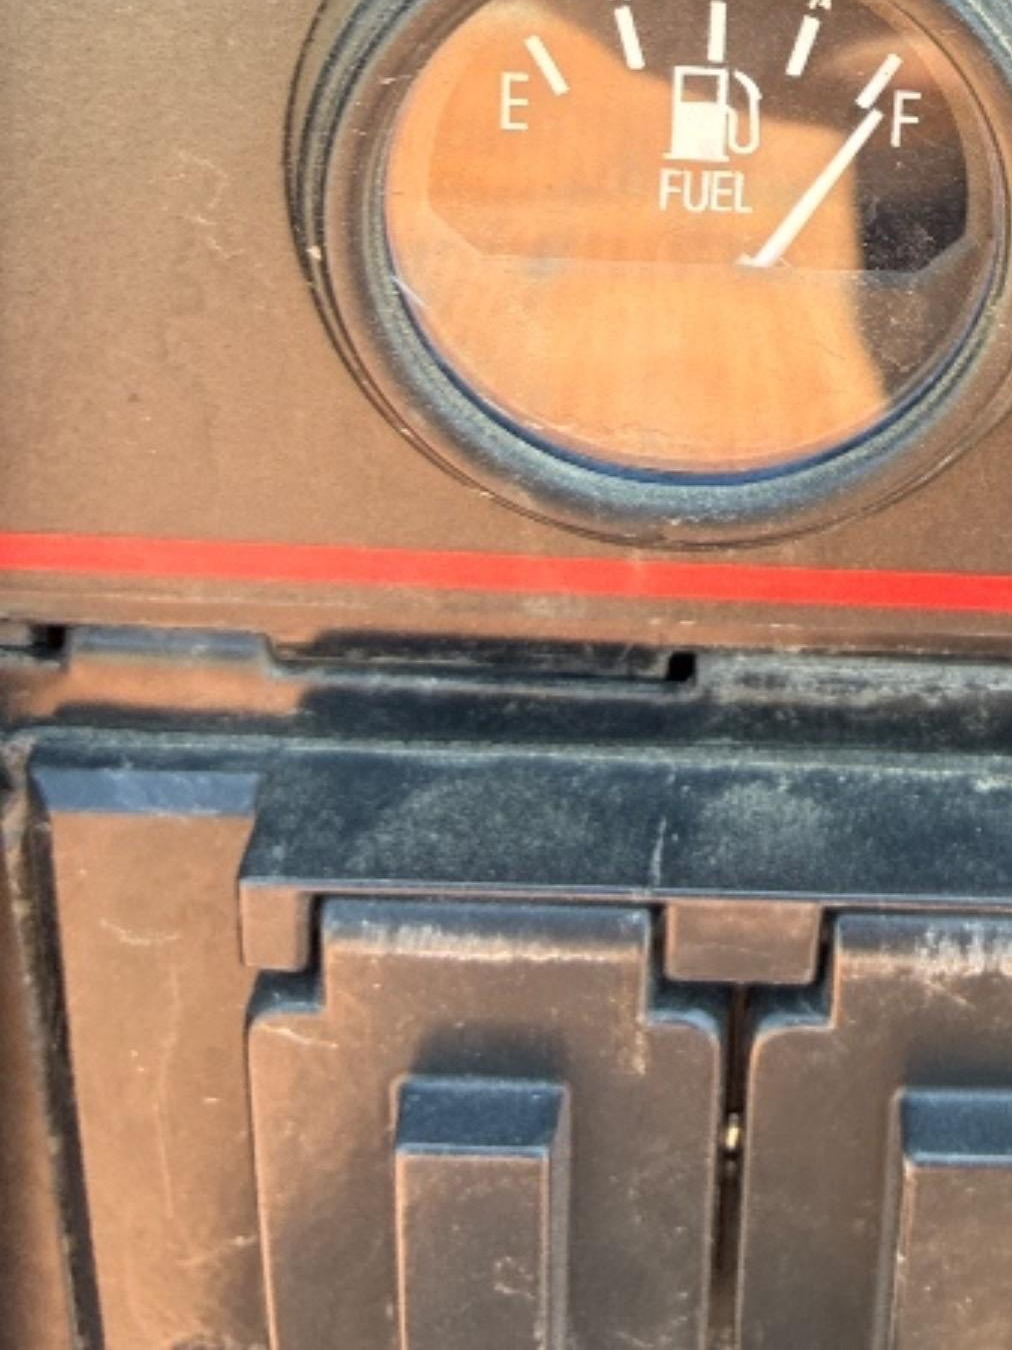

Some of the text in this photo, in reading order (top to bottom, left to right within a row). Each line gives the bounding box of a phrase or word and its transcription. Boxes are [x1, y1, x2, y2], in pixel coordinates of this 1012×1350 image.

[500, 71, 529, 131] E
[890, 90, 922, 148] F
[658, 168, 753, 213] FUEL
